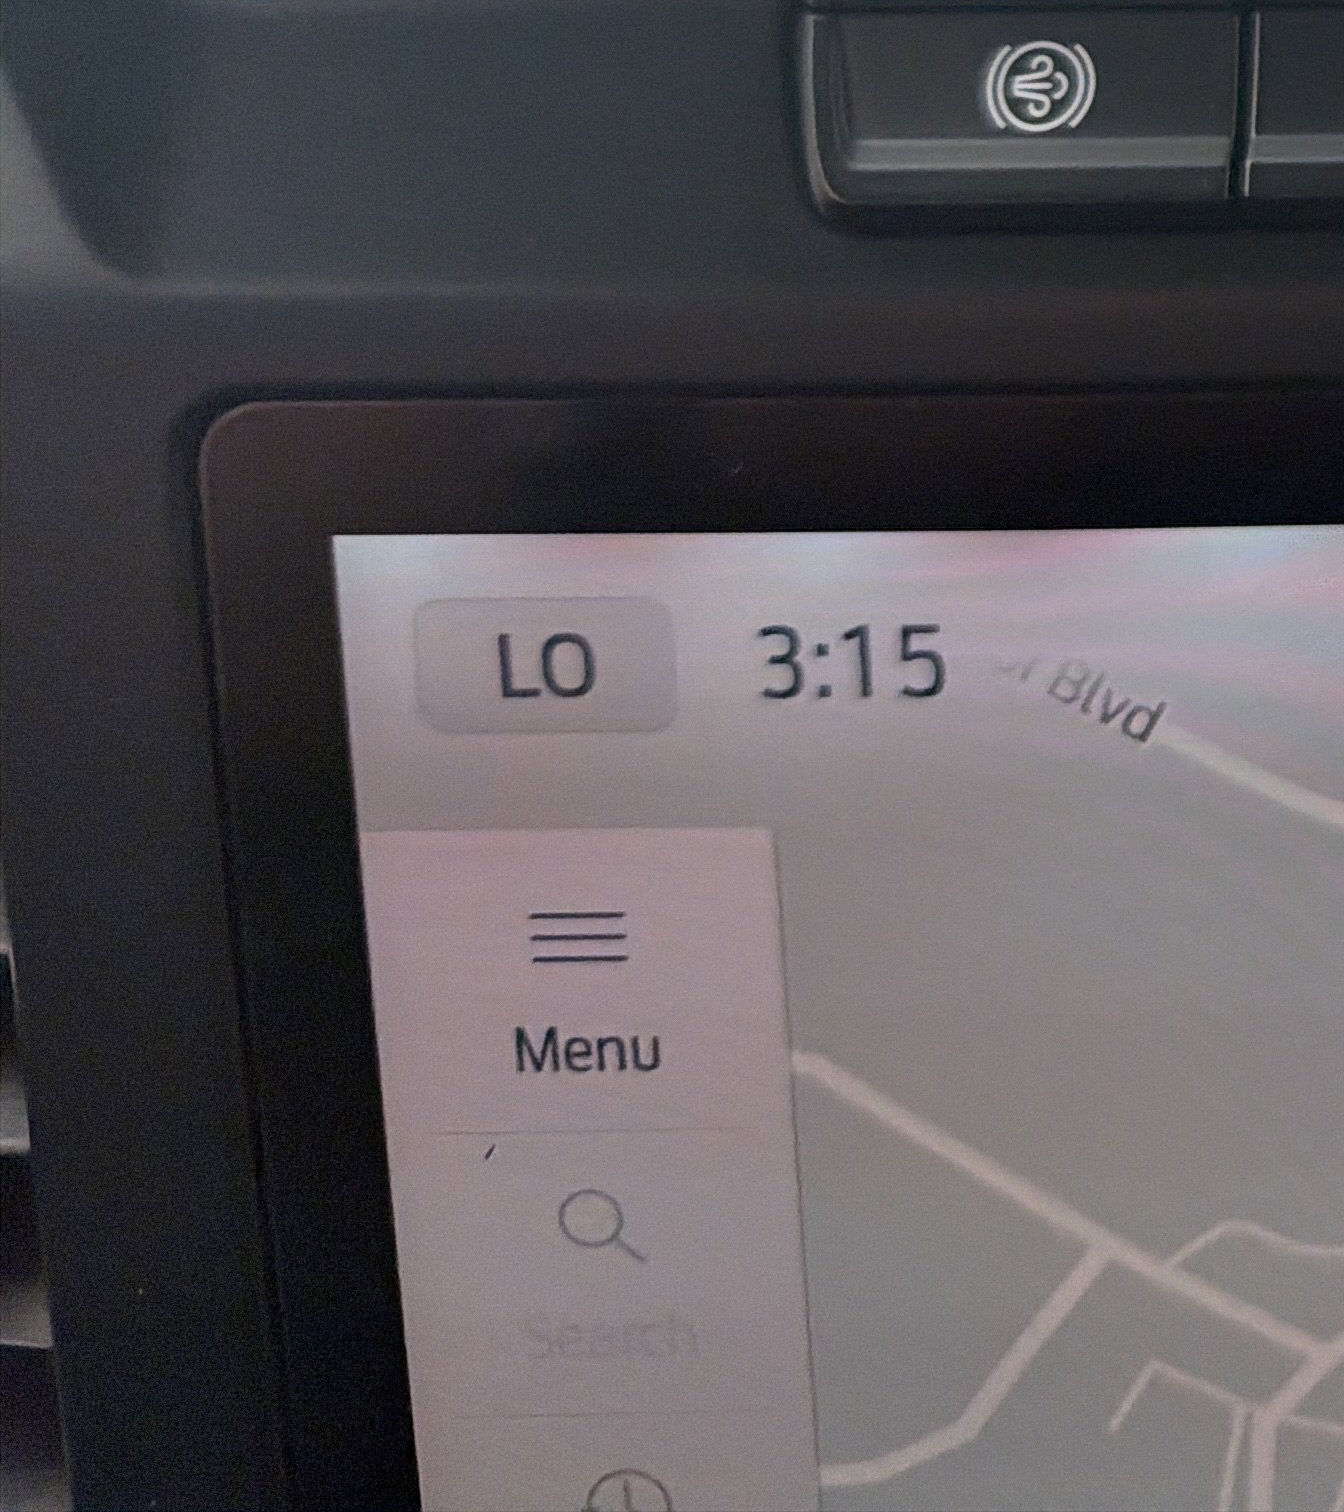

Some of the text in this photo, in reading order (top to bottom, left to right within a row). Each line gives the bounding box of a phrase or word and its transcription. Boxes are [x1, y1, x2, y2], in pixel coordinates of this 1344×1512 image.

[496, 632, 597, 700] LO
[756, 623, 947, 701] 3:15
[1047, 657, 1167, 744] Blvd
[513, 1025, 663, 1075] Menu
